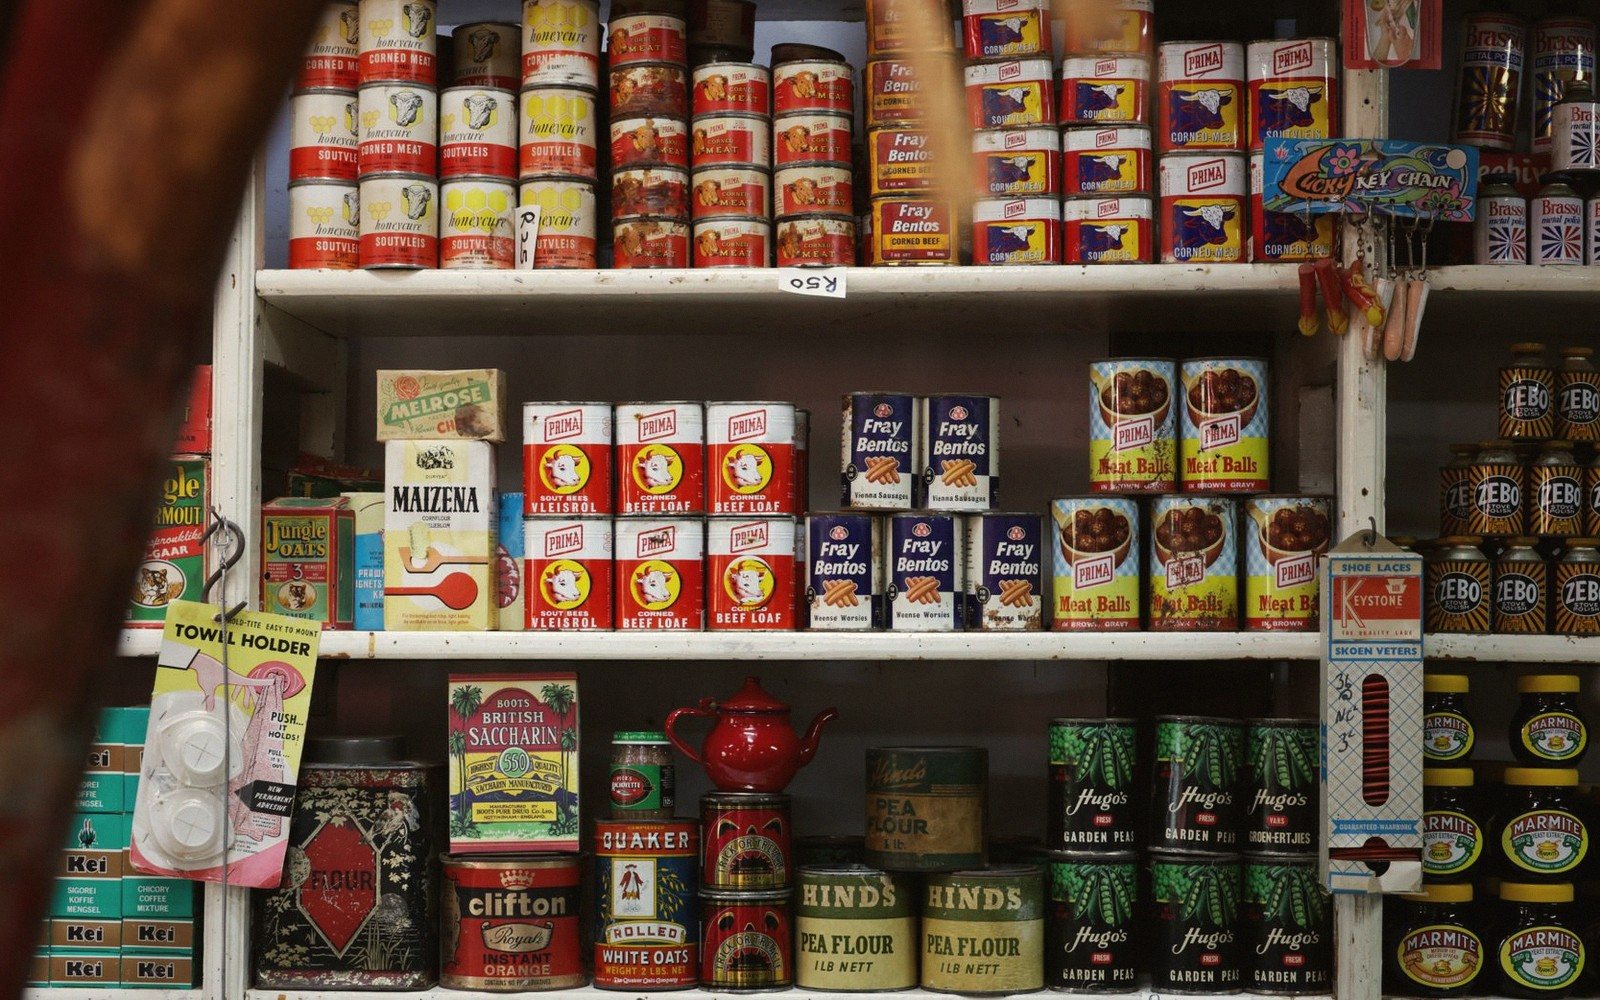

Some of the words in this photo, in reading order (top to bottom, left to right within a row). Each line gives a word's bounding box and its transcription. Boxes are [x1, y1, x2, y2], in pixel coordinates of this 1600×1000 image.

[376, 37, 423, 50] honeycure
[369, 52, 407, 65] CORNED
[410, 53, 432, 66] MEAT
[1188, 49, 1220, 71] PRIMA
[1097, 62, 1116, 74] PRIMA
[528, 121, 587, 137] honeycure
[361, 143, 394, 157] CORNED
[397, 144, 423, 156] MEAT
[443, 147, 489, 158] SOUTVLEIS
[1191, 165, 1224, 187] PRIMA
[1356, 171, 1392, 190] KEY
[1397, 172, 1452, 189] CHAIN
[899, 205, 933, 219] Fray
[1006, 203, 1024, 216] PRIMA
[1542, 199, 1582, 216] Brasso
[374, 219, 423, 232] honeycure
[892, 220, 940, 233] Bentos
[375, 236, 426, 250] SOUTVLEIS
[891, 238, 921, 246] CORNED
[923, 238, 940, 246] BEEF
[790, 276, 837, 293] R50
[391, 386, 483, 421] MELROSE
[1506, 385, 1548, 408] ZEBO
[548, 416, 581, 435] PRIMA
[642, 417, 674, 436] PRIMA
[732, 417, 764, 436] PRIMA
[863, 419, 903, 435] Fray
[1119, 425, 1150, 445] PRIMA
[856, 437, 909, 454] Bentos
[1098, 458, 1132, 475] Meat
[1136, 458, 1170, 475] Balls
[1187, 457, 1219, 474] Meat
[1222, 456, 1258, 474] Balls
[393, 485, 480, 513] MAIZENA
[855, 492, 878, 500] Vienna
[878, 492, 909, 501] Sausages
[1478, 482, 1520, 506] ZEBO
[1541, 482, 1581, 507] ZEBO
[531, 502, 597, 513] VLEISROL
[625, 502, 658, 513] BEEF
[661, 502, 692, 512] LOAF
[267, 520, 326, 553] Jungle
[548, 532, 581, 551] PRIMA
[280, 543, 326, 558] OATS
[820, 542, 860, 559] Fray
[902, 539, 942, 556] Fray
[293, 563, 304, 580] 3
[814, 560, 867, 576] Bentos
[896, 557, 949, 573] Bentos
[1077, 562, 1111, 584] PRIMA
[1342, 563, 1371, 572] SHOE
[1377, 563, 1411, 572] LACES
[1440, 578, 1481, 602] ZEBO
[1059, 596, 1093, 613] Meat
[1097, 595, 1131, 613] Balls
[1340, 578, 1403, 628] KEYSTONE
[623, 618, 653, 629] BEEF
[658, 618, 689, 628] LOAF
[813, 614, 838, 622] Weense
[840, 615, 868, 623] Worsies
[266, 623, 283, 632] EASY
[285, 626, 294, 634] TO
[295, 629, 318, 637] MOUNT
[175, 624, 236, 645] TOWEL
[241, 633, 311, 657] HOLDER
[1335, 647, 1373, 655] SKOEN
[1376, 647, 1418, 655] VETERS
[497, 699, 530, 708] BOOTS
[482, 711, 544, 725] BRITISH
[1531, 716, 1580, 732] MARMITE
[268, 731, 300, 742] HOLDS!
[469, 726, 560, 746] SACCHARIN
[503, 753, 527, 773] 550
[534, 761, 559, 773] QUALITY
[268, 785, 283, 793] NEW
[508, 779, 553, 792] MANUFACTURED
[254, 792, 293, 804] PERMANENT
[1065, 788, 1128, 816] Hugo's
[1168, 786, 1233, 813] Hugo's
[256, 801, 287, 812] ADHESIVE
[876, 799, 917, 817] PEA
[1096, 816, 1112, 824] FRESH
[1514, 815, 1581, 836] MARMITE
[603, 831, 689, 850] QUAKER
[1064, 831, 1108, 843] GARDEN
[1114, 831, 1135, 843] PEAS
[1165, 827, 1209, 842] GARDEN
[67, 855, 108, 874] Kei
[311, 869, 375, 892] FLOUR
[69, 896, 95, 904] KOFFIE
[139, 895, 167, 903] COFFEE
[803, 884, 897, 908] HINDS
[928, 885, 1023, 910] HINDS
[67, 905, 101, 914] MENGSEL
[468, 892, 567, 917] clifton
[138, 925, 175, 943] Kei
[614, 926, 678, 940] ROLLED
[1407, 931, 1477, 951] MARMITE
[801, 933, 828, 954] PEA
[831, 934, 894, 955] FLOUR
[483, 953, 552, 964] INSTANT
[602, 950, 650, 965] WHITE
[653, 949, 689, 964] OATS
[484, 964, 551, 976] ORANGE
[605, 966, 637, 976] WEIGHT
[641, 967, 647, 975] 2
[650, 966, 669, 976] LBS.
[672, 966, 686, 975] NET
[820, 961, 835, 972] LB
[839, 962, 874, 973] NETT
